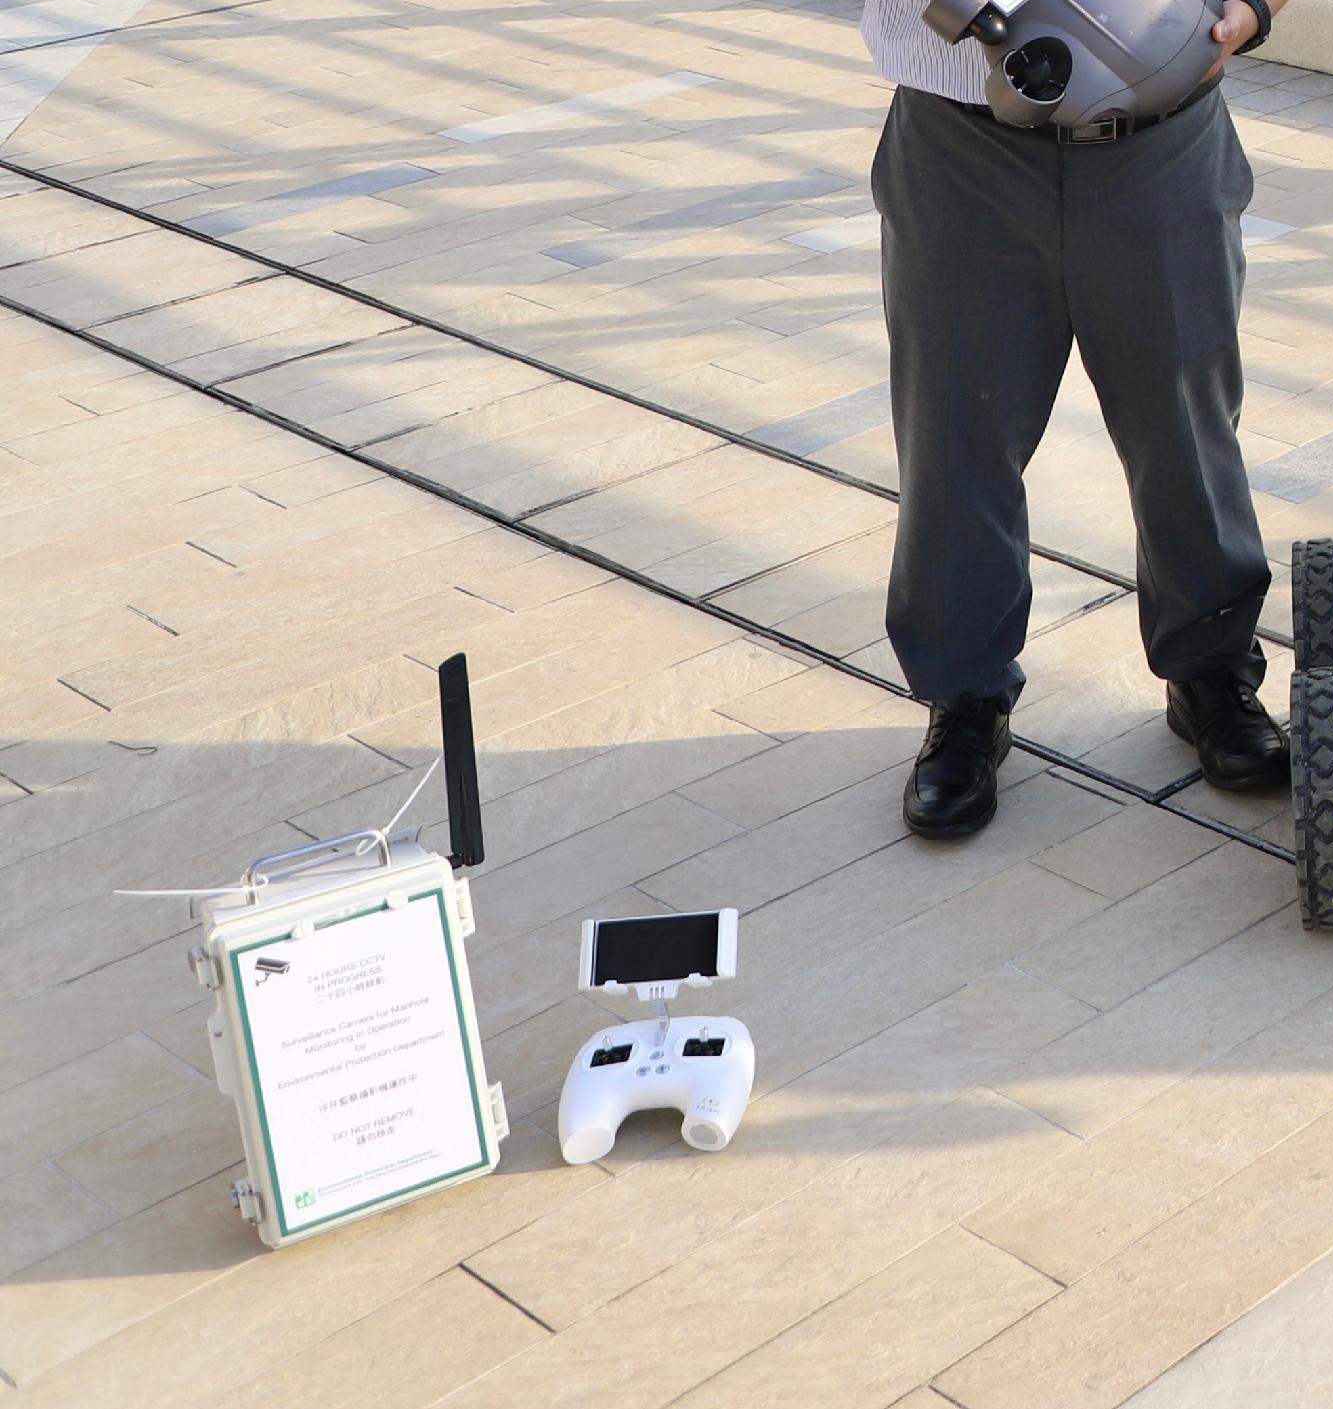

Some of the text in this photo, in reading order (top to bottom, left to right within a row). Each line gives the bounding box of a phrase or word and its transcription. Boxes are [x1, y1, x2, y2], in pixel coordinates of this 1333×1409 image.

[321, 962, 358, 981] HOURS
[359, 953, 387, 968] CCTV
[327, 966, 383, 989] PROGRESS
[281, 996, 430, 1049] Surveillance Camera for Manhole
[304, 1033, 354, 1055] Monitoring
[366, 1015, 411, 1037] Operation
[278, 1029, 445, 1090] Environmental Protection Department
[354, 1043, 366, 1052] by
[333, 1107, 416, 1142] DO NOT REMOVE
